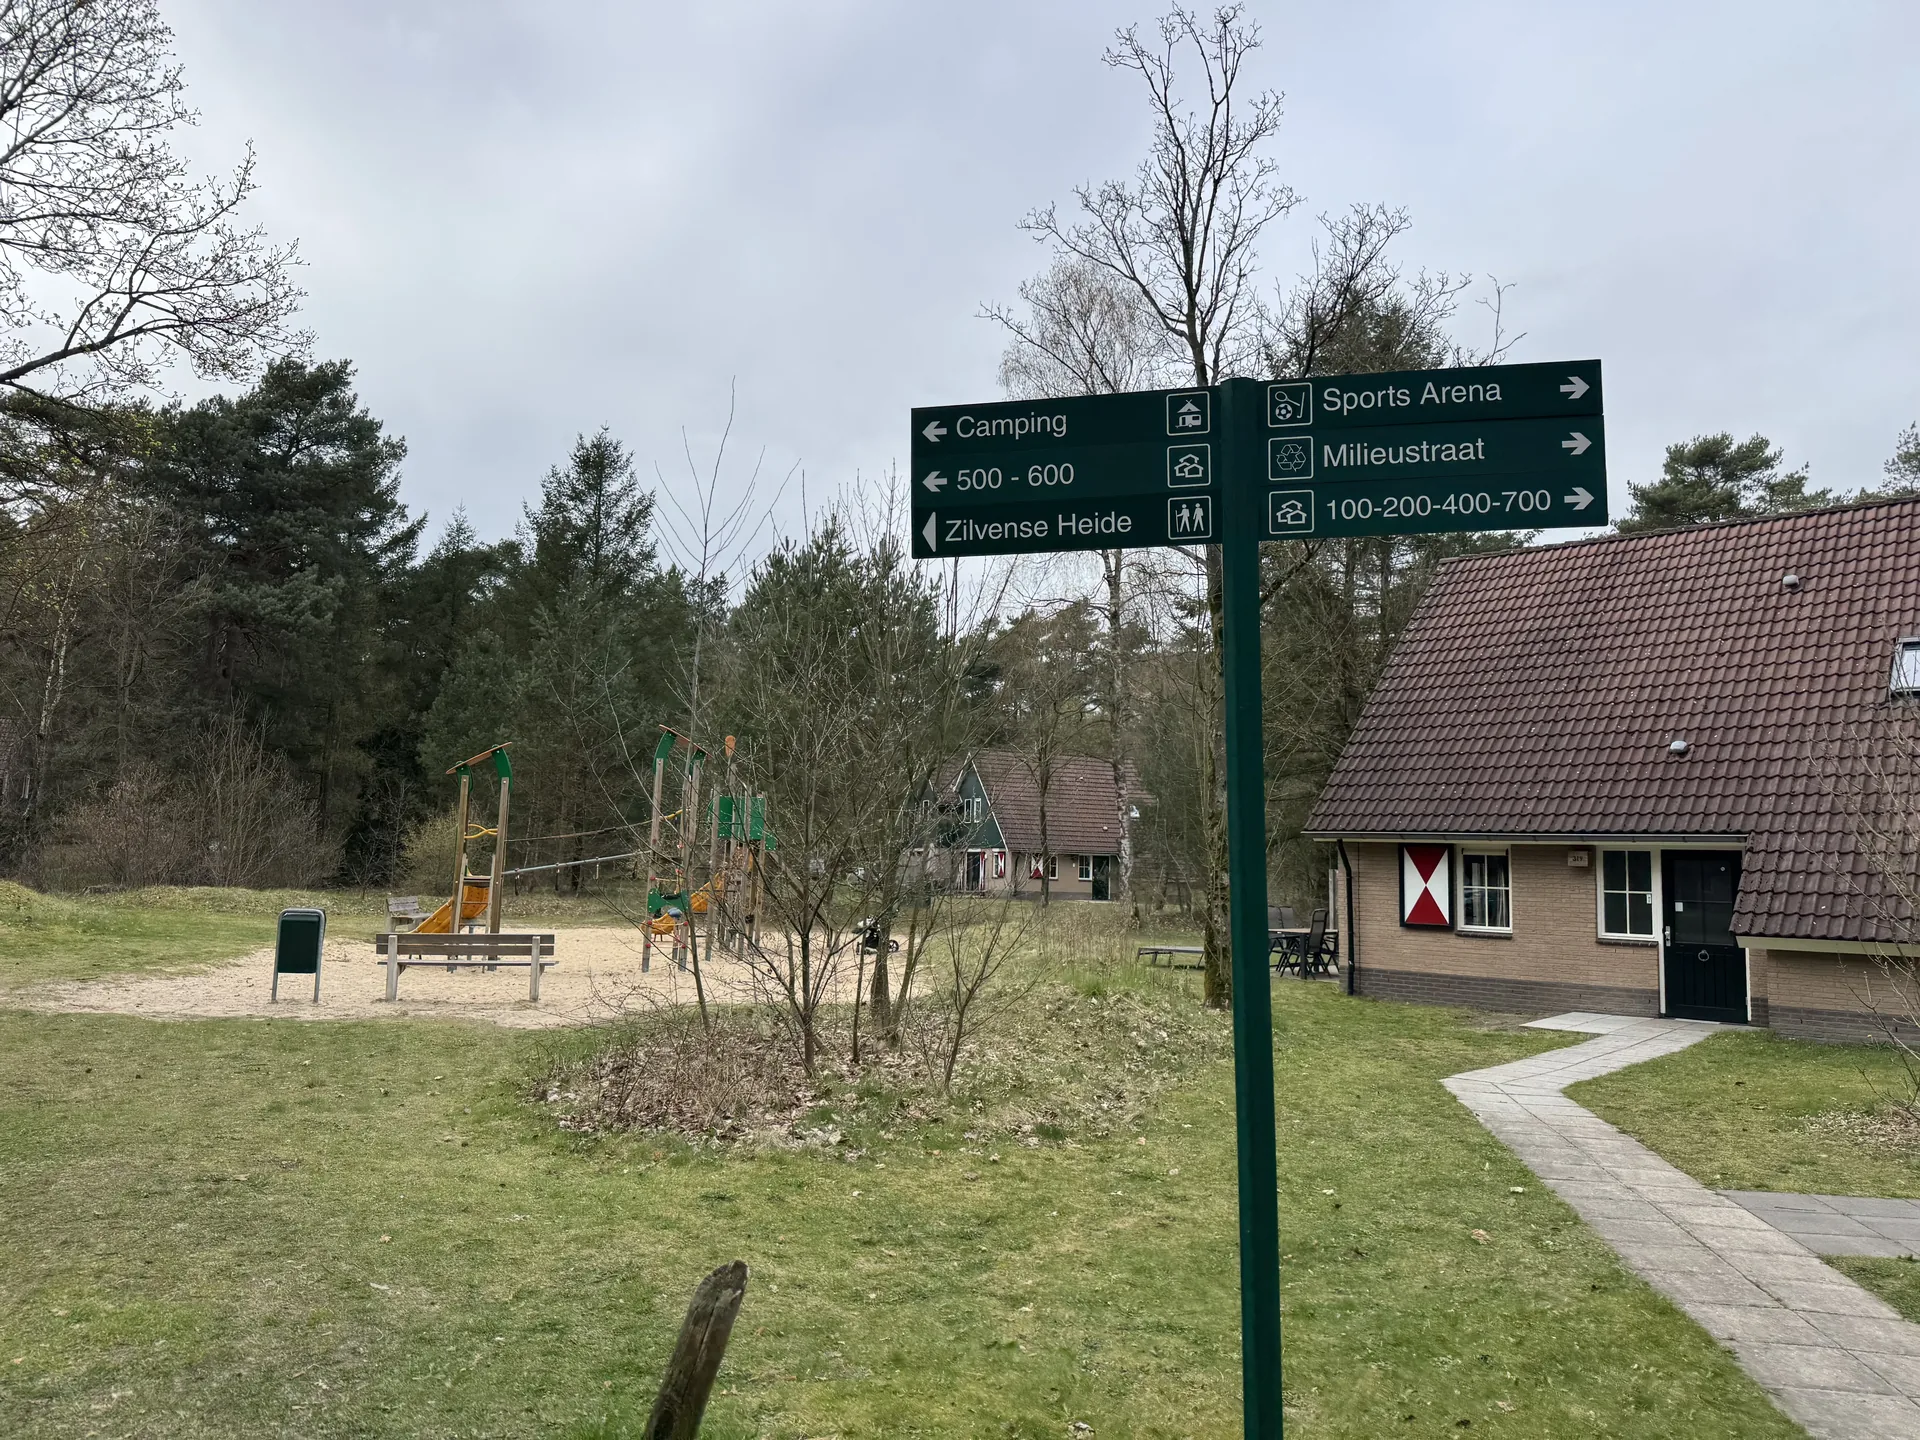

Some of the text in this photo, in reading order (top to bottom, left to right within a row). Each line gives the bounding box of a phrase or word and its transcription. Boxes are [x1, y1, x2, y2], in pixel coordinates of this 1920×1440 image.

[1323, 380, 1503, 416] Sports Arena
[956, 411, 1067, 440] Camping
[1322, 437, 1486, 468] Milieustraat
[956, 467, 1002, 491] 500
[1027, 462, 1075, 486] 600
[1326, 489, 1552, 521] 100-200-400-700
[945, 511, 1133, 542] Zilvense Heide
